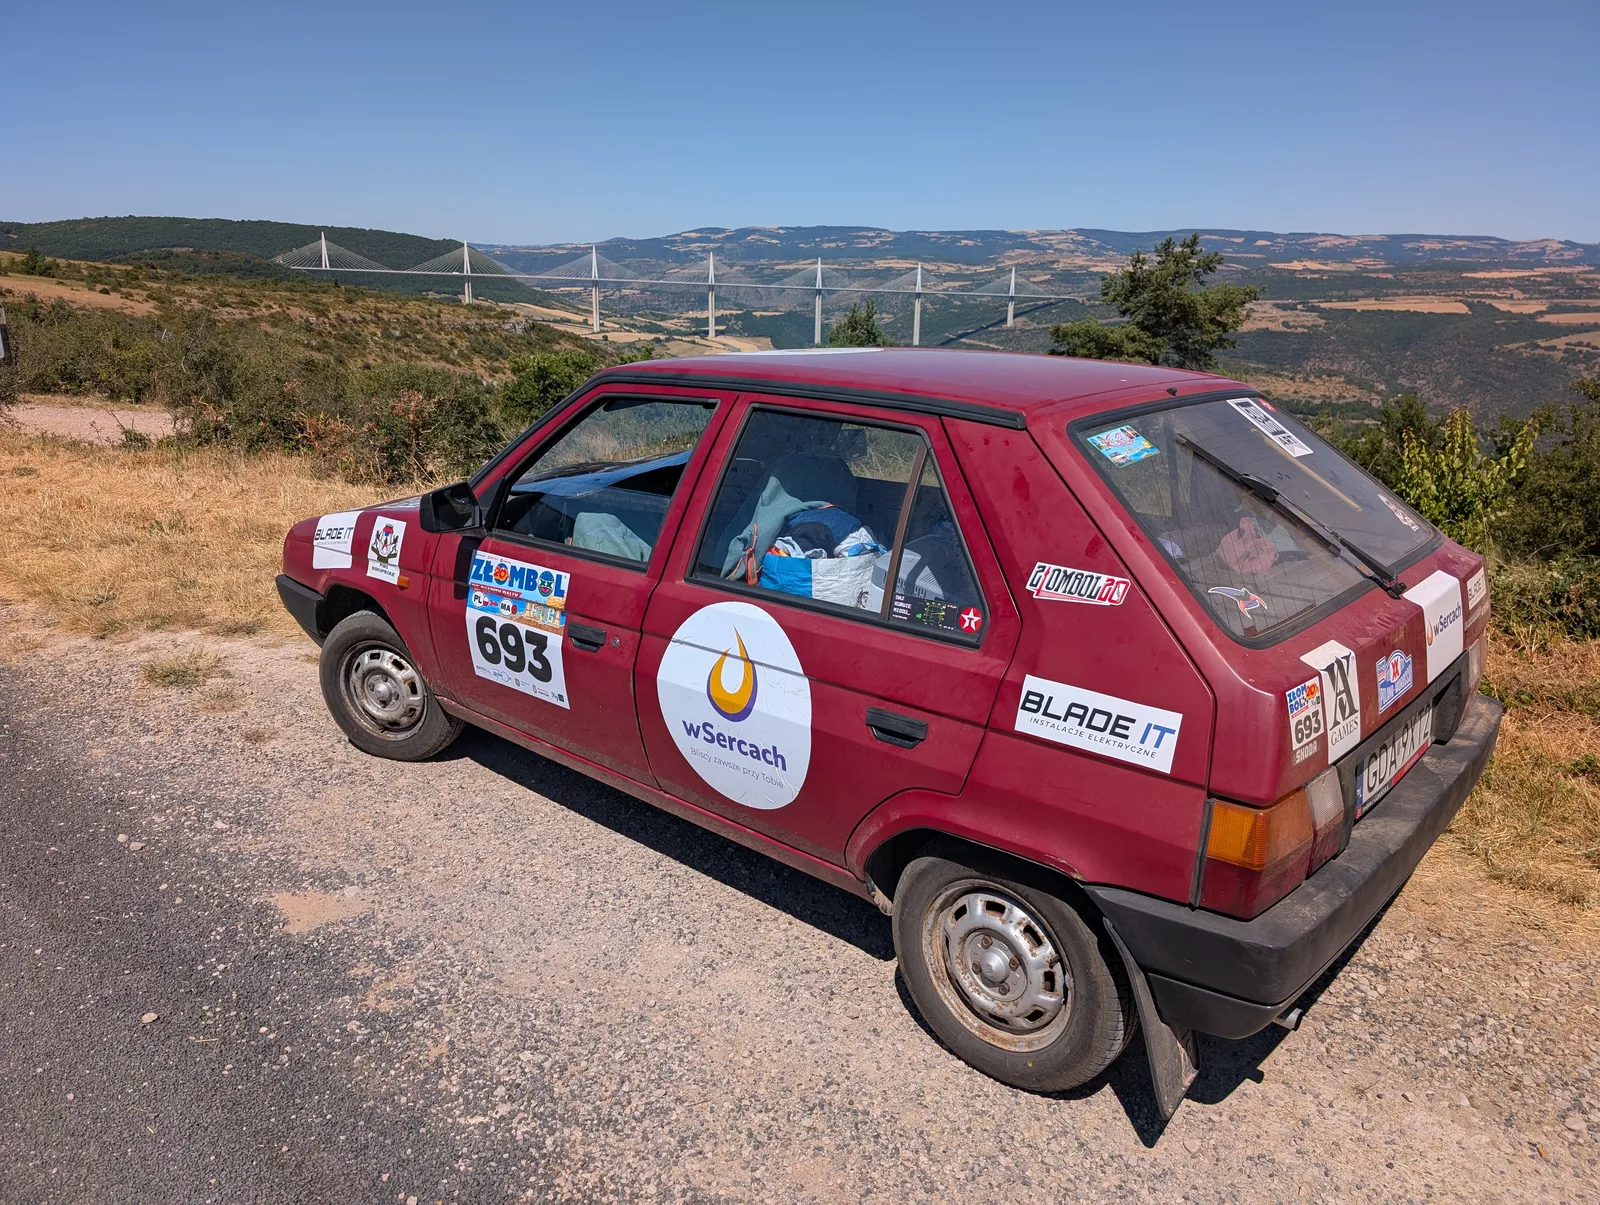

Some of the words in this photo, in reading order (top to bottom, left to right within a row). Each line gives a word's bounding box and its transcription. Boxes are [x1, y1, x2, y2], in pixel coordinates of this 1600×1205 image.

[314, 527, 344, 541] BLADE
[474, 594, 482, 604] PL
[500, 603, 511, 612] MA
[1433, 602, 1461, 637] wSercach
[475, 615, 553, 683] 693
[1020, 690, 1136, 740] BLADE
[1139, 722, 1176, 749] IT
[1030, 716, 1085, 738] INSTALACJE
[1087, 733, 1157, 759] ELEKTRYCZNE
[1294, 709, 1321, 744] 693
[1330, 716, 1359, 746] GAMES
[681, 720, 787, 772] wSercach
[1367, 735, 1397, 793] GDA
[690, 747, 712, 763] Bliscy
[713, 757, 741, 772] zawsze
[742, 767, 760, 780] przy
[760, 772, 784, 789] Tobie
